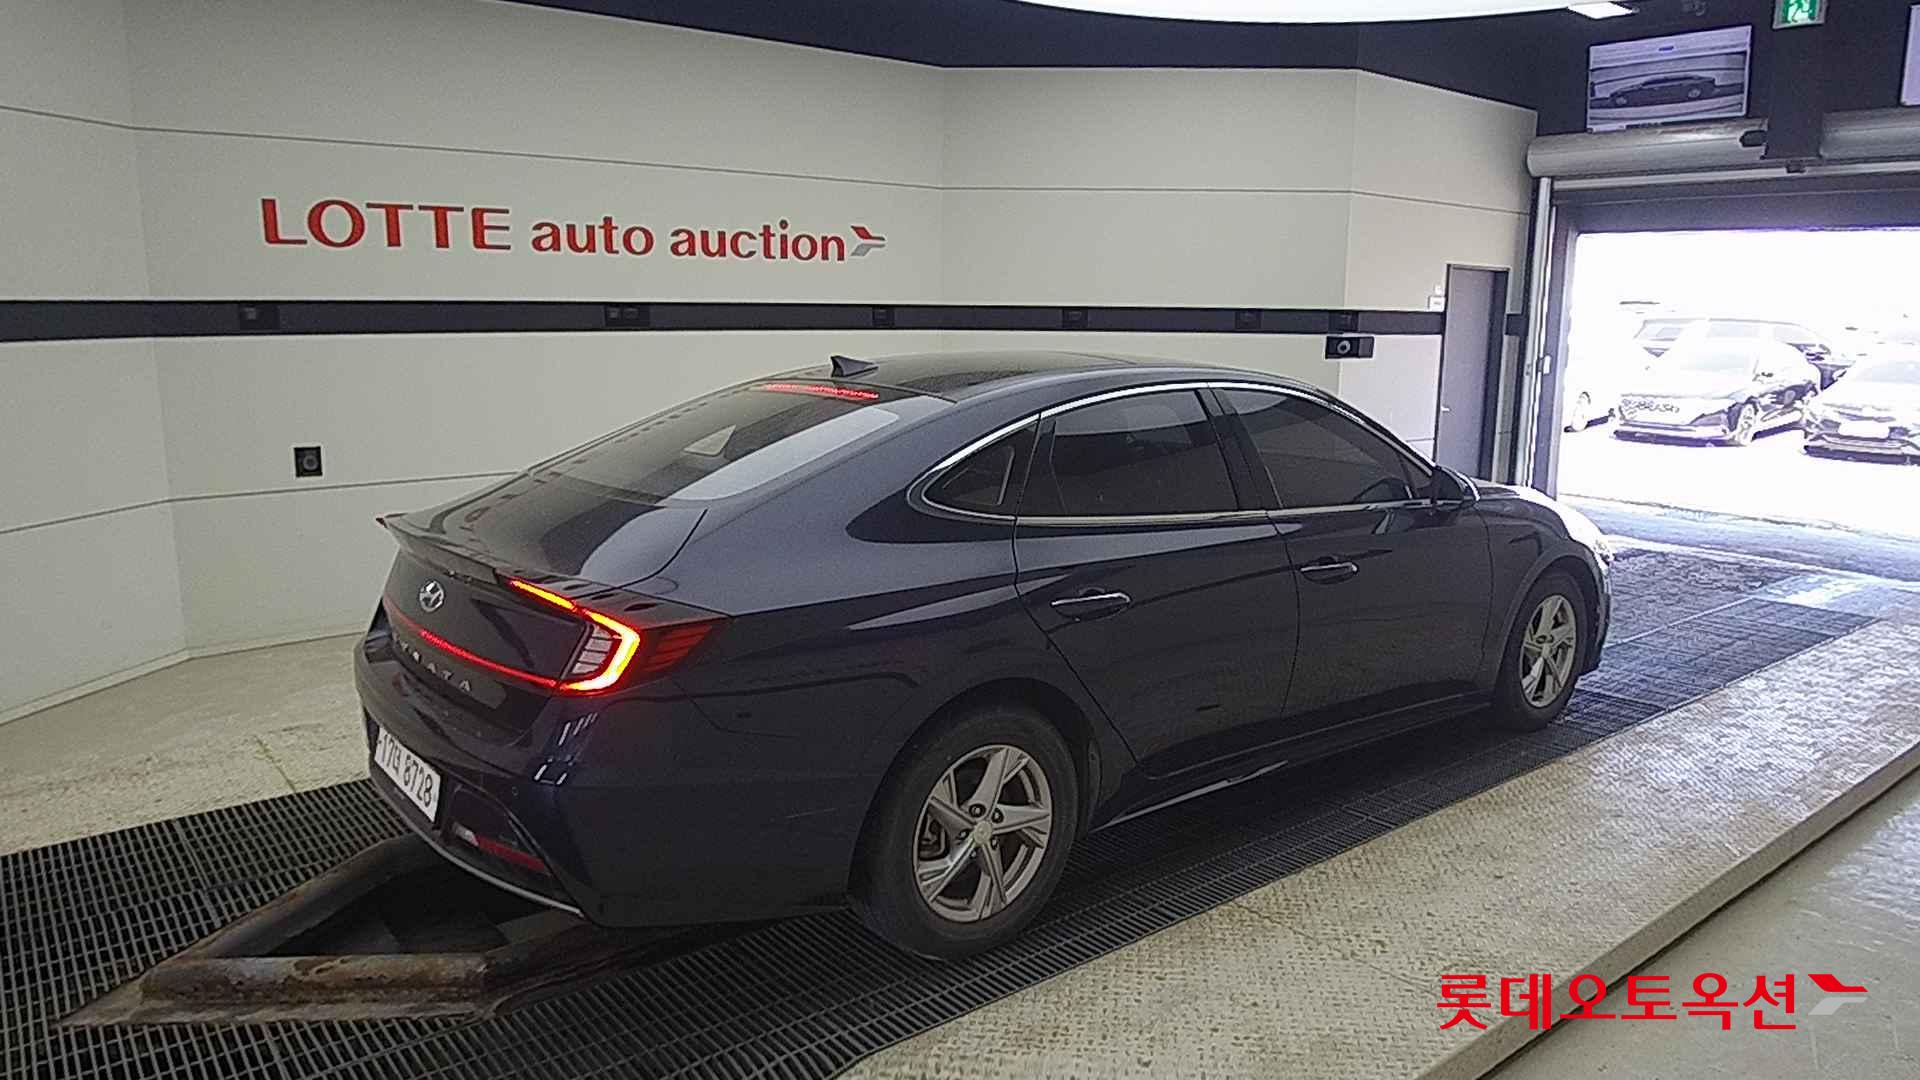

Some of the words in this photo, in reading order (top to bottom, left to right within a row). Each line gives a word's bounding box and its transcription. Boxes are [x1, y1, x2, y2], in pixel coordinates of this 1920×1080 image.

[261, 198, 511, 251] LOTTE
[531, 216, 655, 256] auto
[670, 220, 847, 261] auction
[403, 754, 433, 808] 8728
